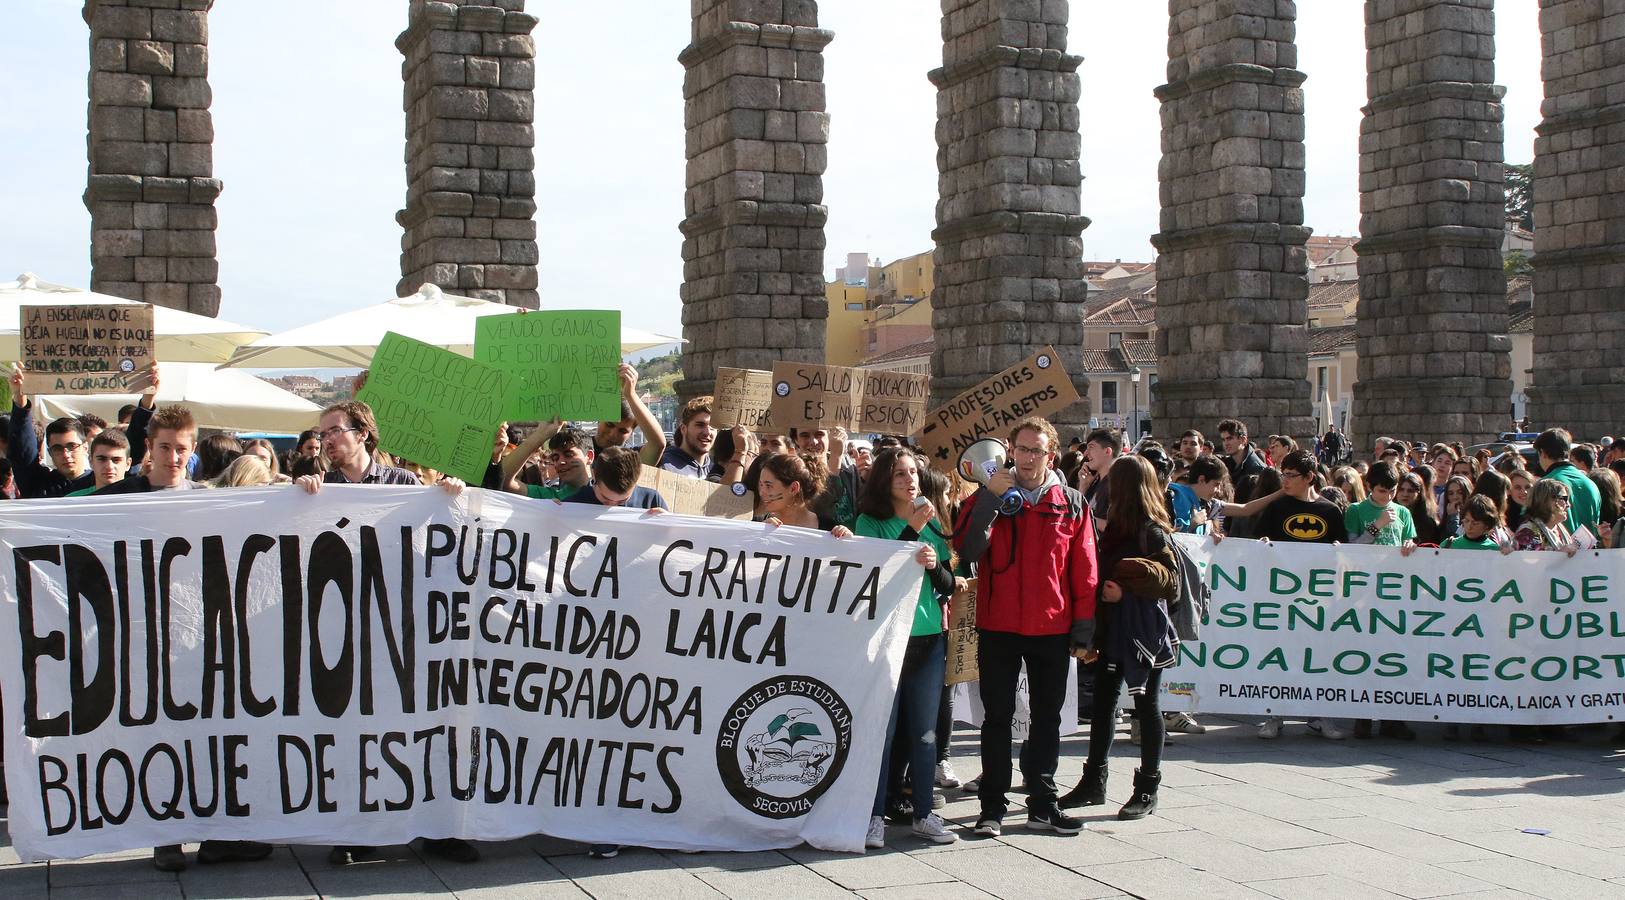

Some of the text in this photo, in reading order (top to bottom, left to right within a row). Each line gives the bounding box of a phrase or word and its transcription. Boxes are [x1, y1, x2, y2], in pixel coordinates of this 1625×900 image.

[27, 307, 130, 321] LA ENSEÑANZA QUE
[24, 325, 154, 341] DEJA HUELLA NO ES LA QUE
[486, 319, 608, 340] VENDO GANAS
[25, 343, 148, 356] SE HACE DE CABEZA A CABEZA
[381, 339, 409, 366] LA
[488, 344, 618, 364] DE ESTUDIAR PARA
[375, 373, 393, 387] ES
[379, 363, 398, 374] NO
[560, 368, 582, 391] LA
[796, 369, 851, 394] SALUD
[856, 376, 864, 394] Y
[55, 374, 128, 390] A CORAZÓN
[938, 366, 1035, 428] PROFESORES
[804, 401, 919, 425] ES INVERSIÓN
[951, 385, 1059, 453] ANALFABETOS
[425, 517, 881, 620] PÚBLICA GRATUITA
[1270, 567, 1524, 603] DEFENSA
[1550, 575, 1608, 604] DE
[13, 517, 416, 738] EDUCACIÓN
[427, 591, 787, 667] DE CALIDAD LAICA
[1177, 642, 1250, 669] NO
[1257, 647, 1288, 671] A
[1303, 647, 1408, 677] LOS
[426, 658, 702, 735] INTEGRADORA
[1219, 683, 1625, 711] PLATAFORMA POR LA ESCUELA PUBLICA, LAICA Y GRAT
[721, 691, 766, 749] BLOQUE
[765, 681, 787, 698] DE
[38, 724, 684, 836] BLOQUE DE ESTUDIANTES
[752, 796, 814, 814] SEGOVIA
